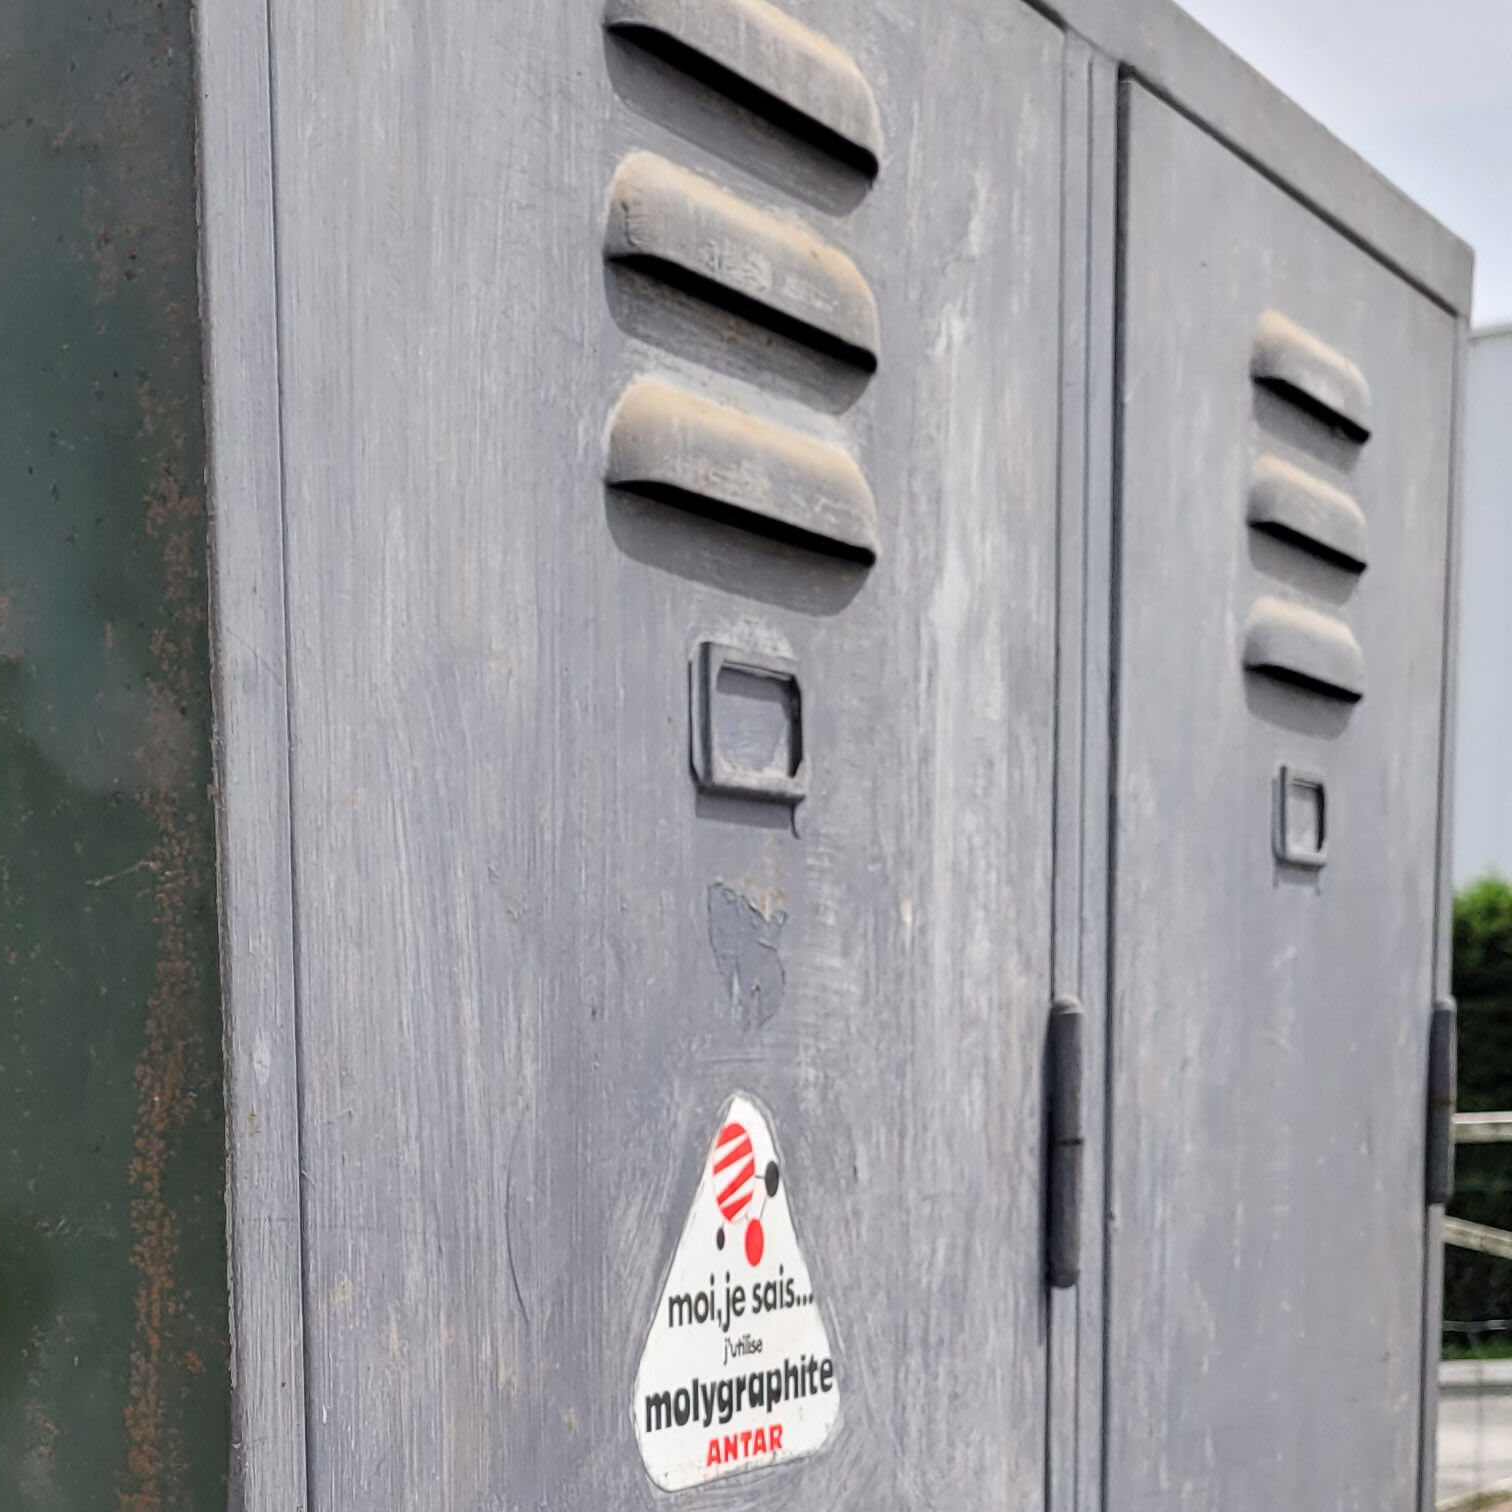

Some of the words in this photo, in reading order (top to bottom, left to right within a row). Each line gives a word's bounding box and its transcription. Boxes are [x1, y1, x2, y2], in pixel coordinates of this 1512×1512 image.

[752, 1264, 813, 1314] sais...
[723, 1334, 763, 1366] j'utilise
[645, 1354, 833, 1433] molygraphite
[707, 1423, 784, 1468] ANTAR
